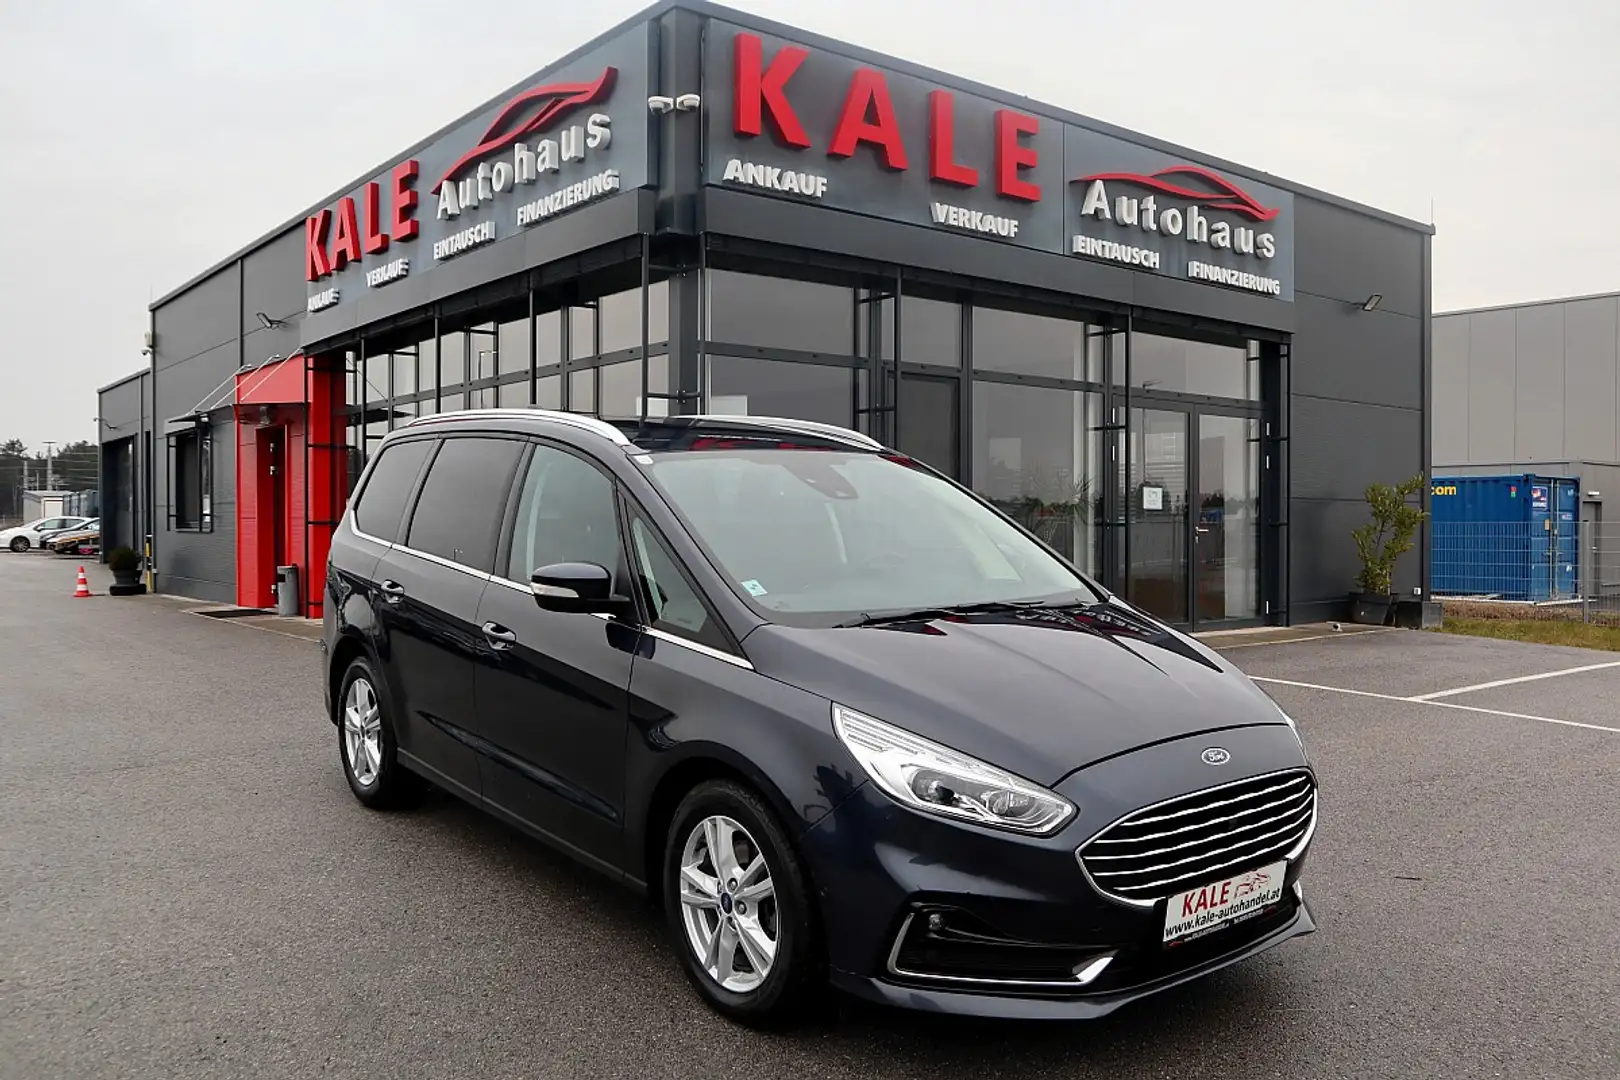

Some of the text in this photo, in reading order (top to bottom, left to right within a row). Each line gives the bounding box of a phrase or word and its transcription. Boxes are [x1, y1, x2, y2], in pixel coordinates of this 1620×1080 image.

[734, 33, 1041, 203] KALE
[435, 113, 612, 221] Autohaus
[722, 158, 828, 199] ANKAUF
[516, 168, 620, 227] FINANZIERUNG
[929, 202, 1019, 238] VERKAUF
[1081, 179, 1276, 259] Autohaus
[305, 159, 419, 282] KALE
[432, 220, 496, 261] EINTAUSCH
[1072, 234, 1160, 270] EINTAUSCH
[1187, 260, 1281, 296] FINANZIERUNG
[1165, 888, 1281, 938] www.kale-autohandel.at
[1181, 881, 1232, 918] KALE
